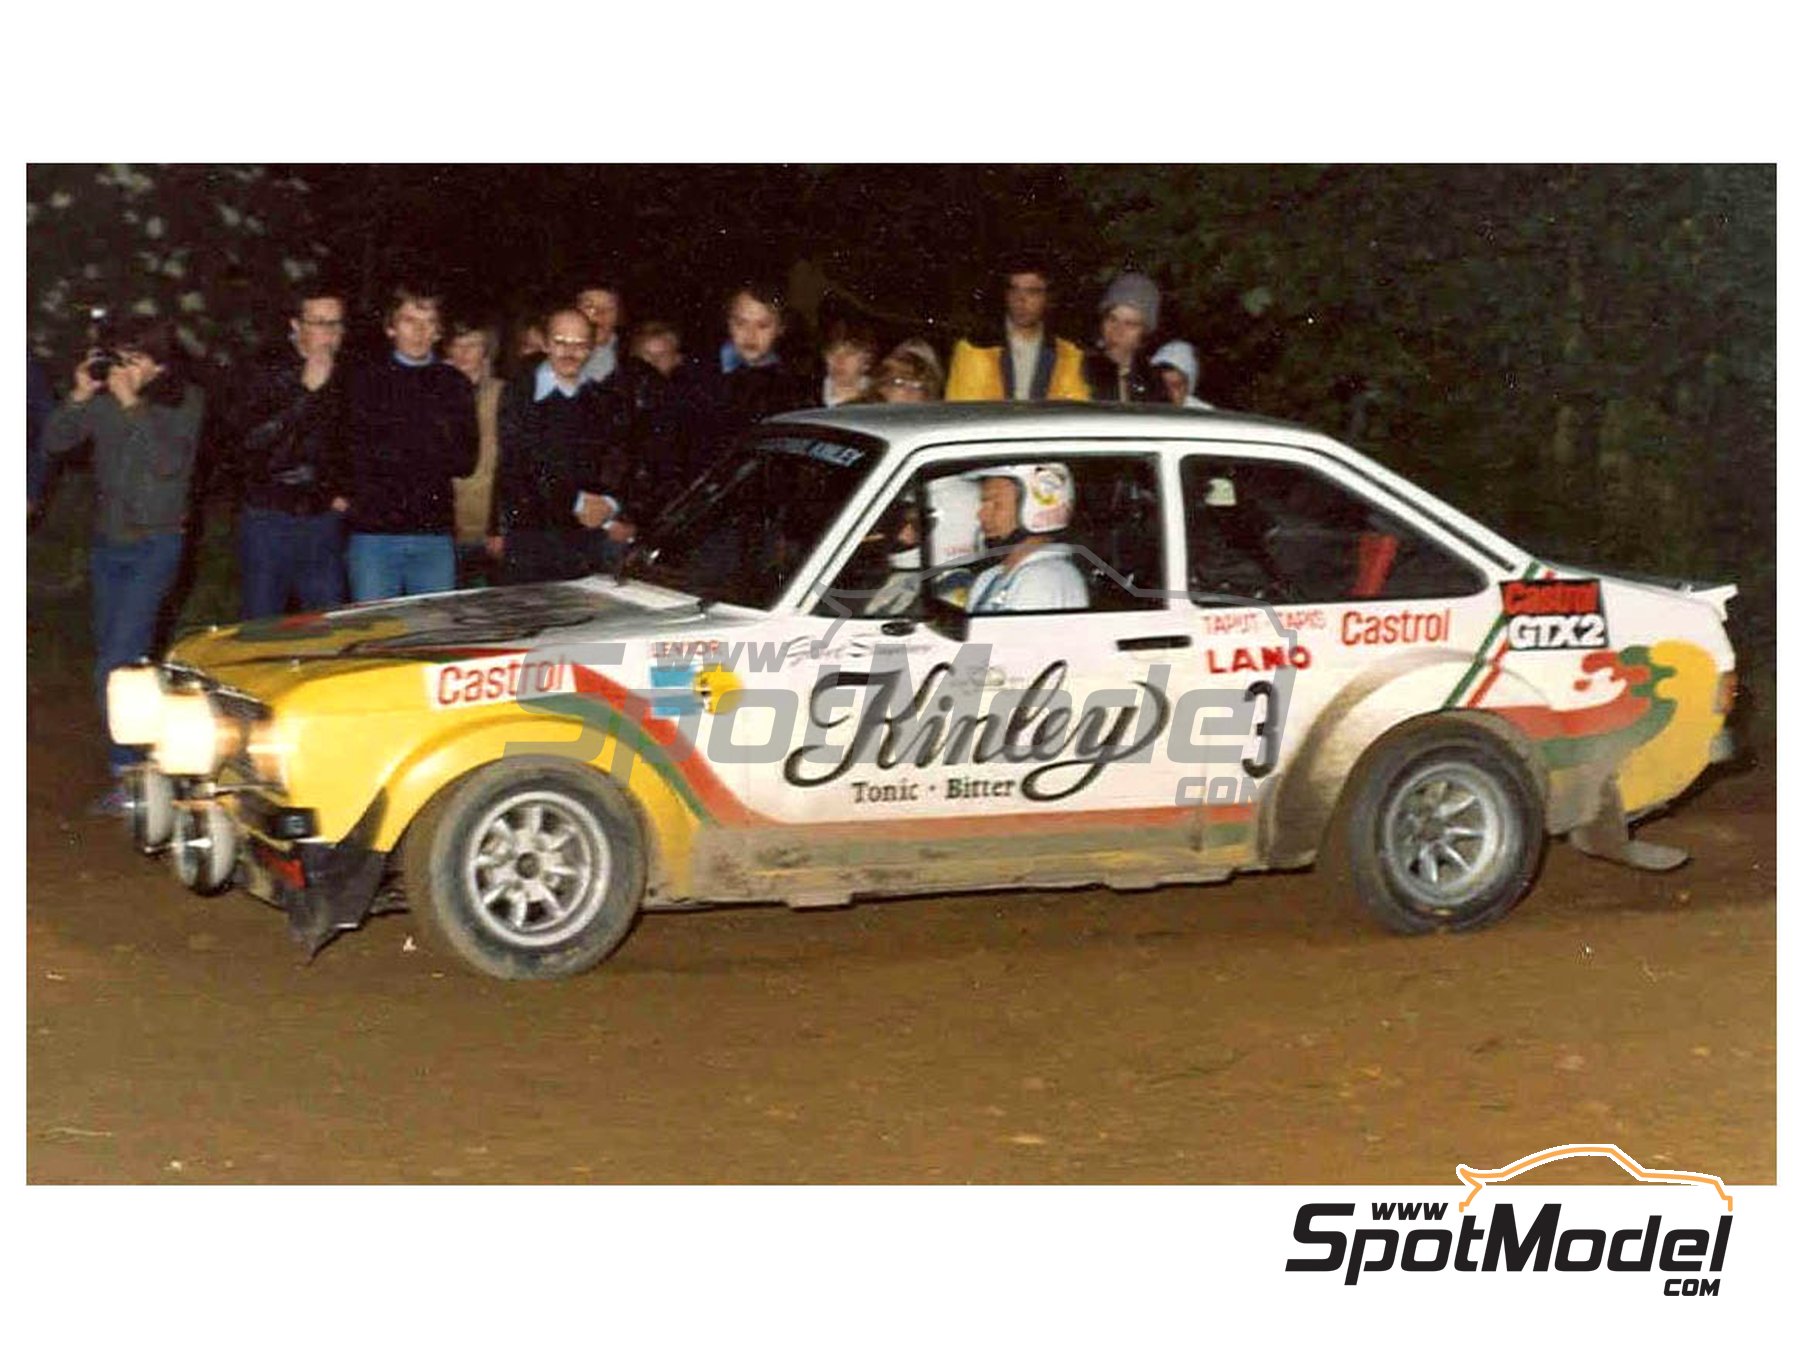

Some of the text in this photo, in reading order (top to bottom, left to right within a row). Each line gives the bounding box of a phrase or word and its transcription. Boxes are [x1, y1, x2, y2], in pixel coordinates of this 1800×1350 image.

[1341, 609, 1450, 647] Castrol
[1508, 613, 1606, 649] GTX2
[1206, 645, 1313, 675] LANO
[436, 656, 567, 706] Castrol
[783, 660, 1170, 803] Kinley
[1242, 681, 1275, 780] 3
[851, 778, 1016, 804] Tonic Bitter
